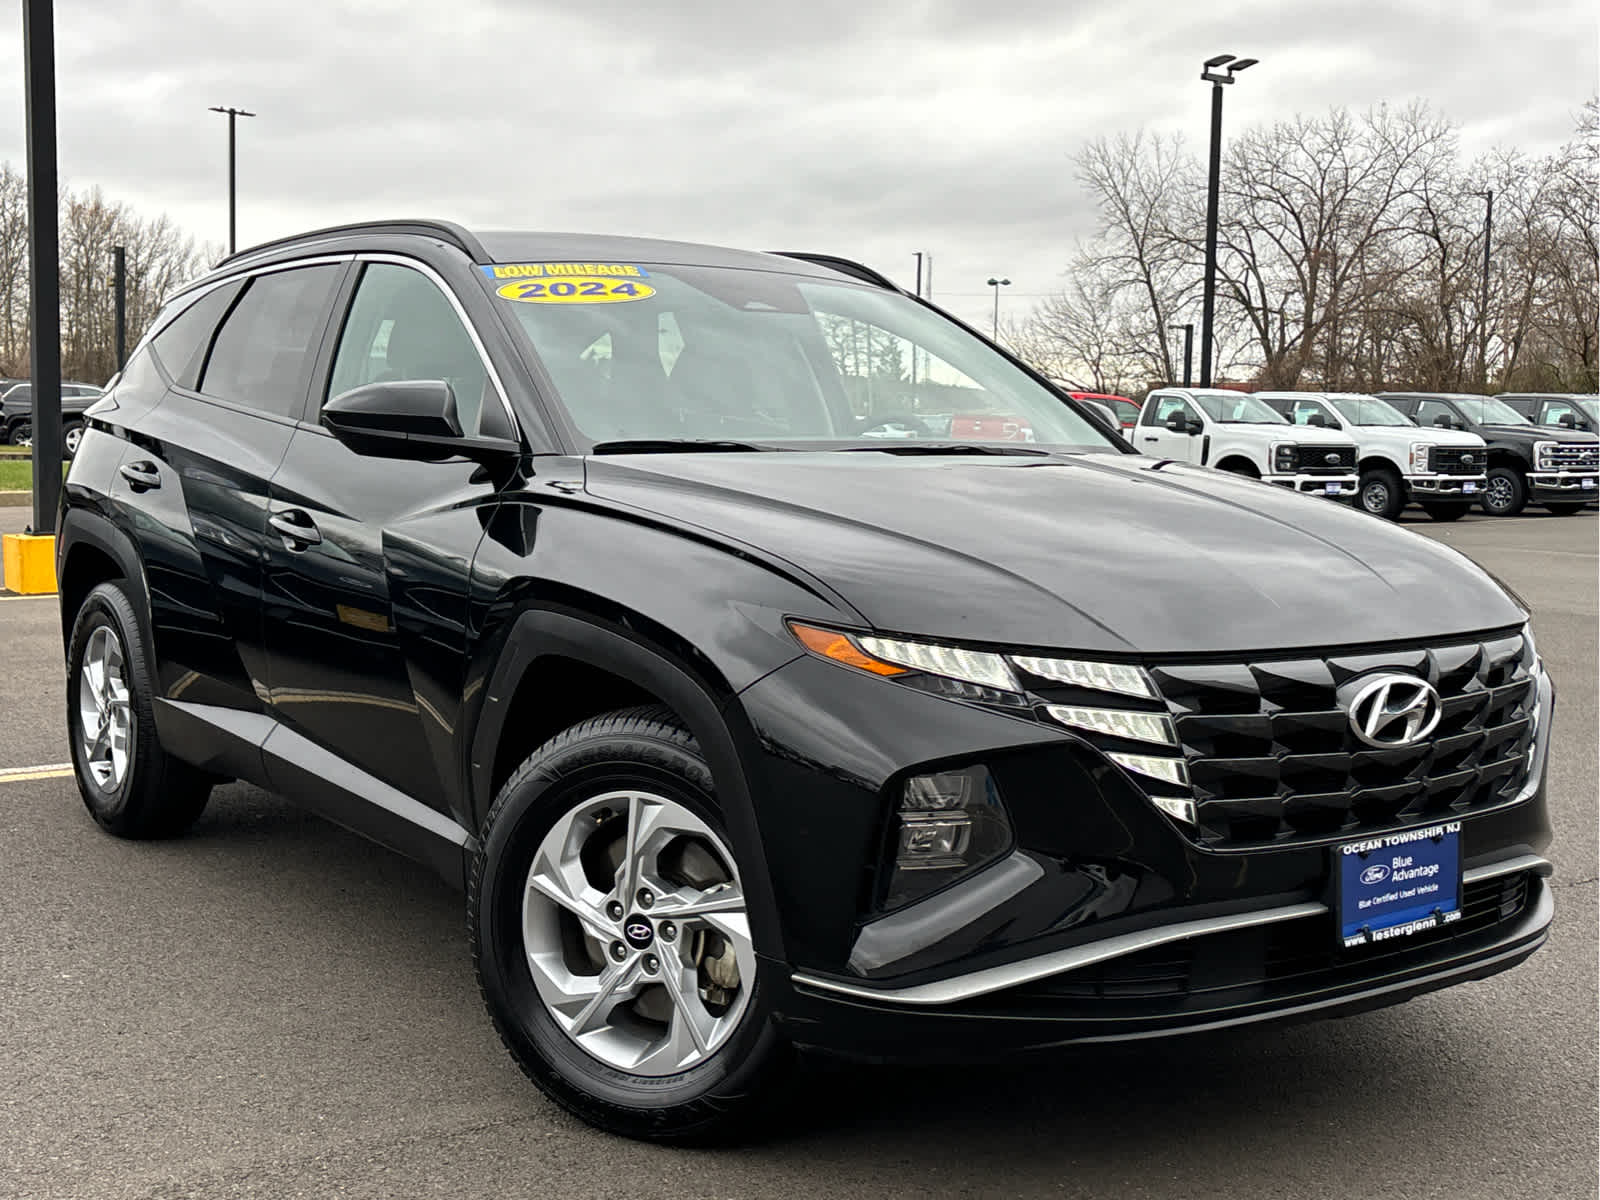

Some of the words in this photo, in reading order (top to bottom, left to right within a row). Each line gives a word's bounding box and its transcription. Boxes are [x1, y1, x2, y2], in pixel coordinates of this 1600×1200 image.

[493, 265, 543, 279] LOW
[544, 263, 641, 277] MILEAGE
[517, 282, 640, 299] 2024
[1343, 840, 1383, 855] OCEAN
[1446, 821, 1461, 833] NJ
[1392, 855, 1413, 869] Blue
[1362, 866, 1387, 883] Ford
[1392, 864, 1439, 882] Advantage
[1358, 898, 1372, 909] Blue
[1372, 892, 1399, 905] Certified
[1399, 888, 1416, 899] Used
[1417, 883, 1439, 895] Vehicle
[1372, 918, 1437, 942] lesterglenn
